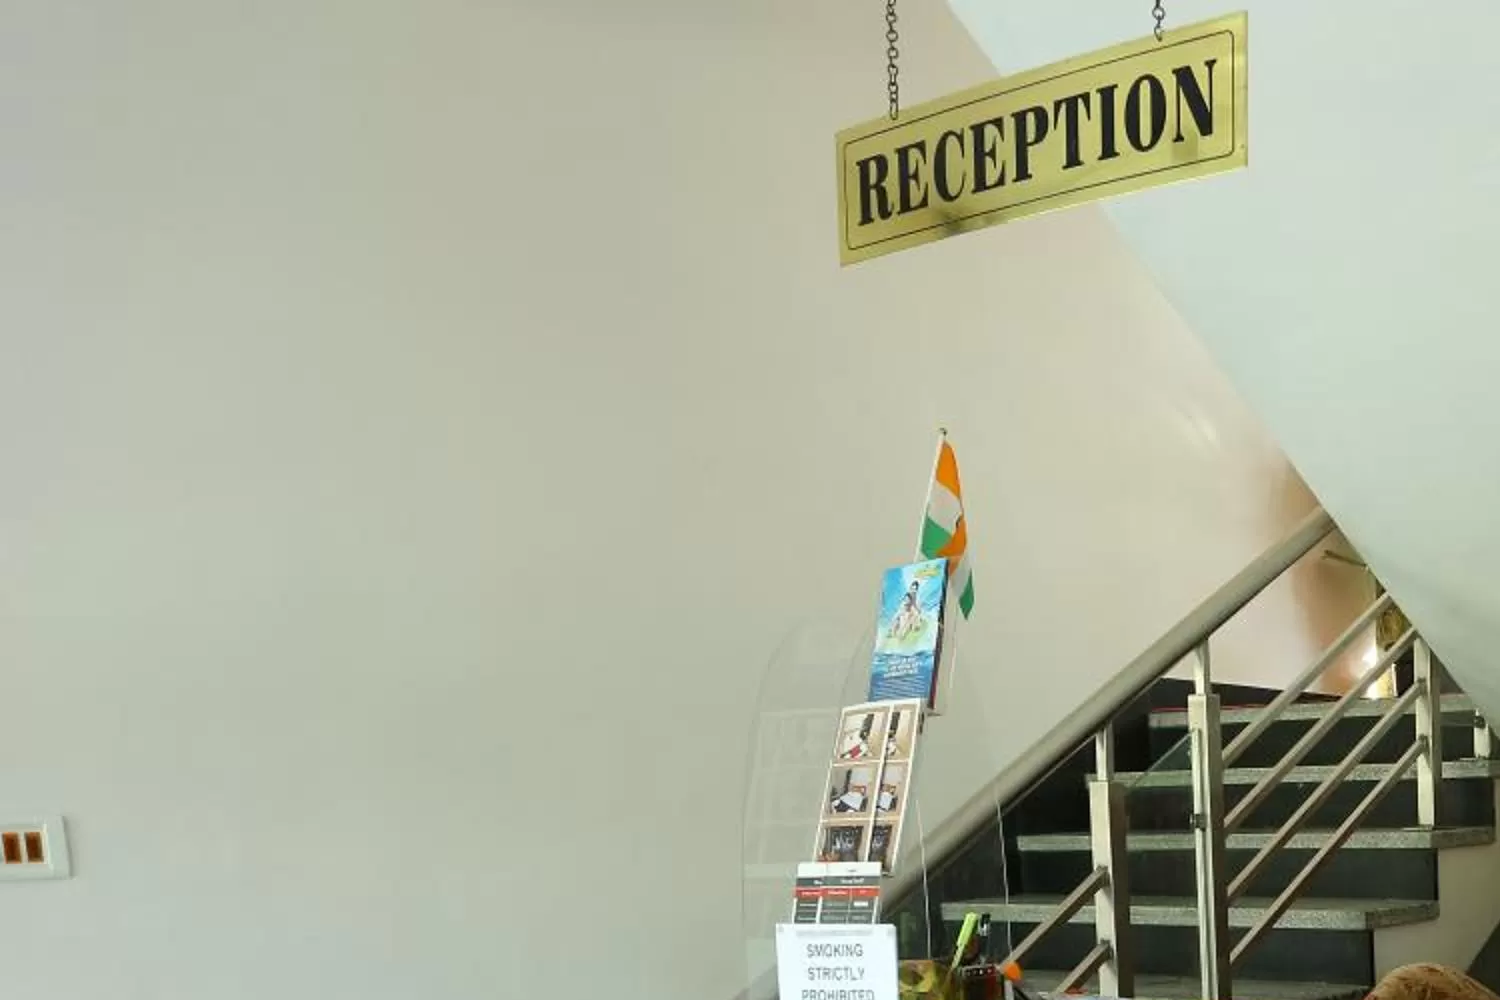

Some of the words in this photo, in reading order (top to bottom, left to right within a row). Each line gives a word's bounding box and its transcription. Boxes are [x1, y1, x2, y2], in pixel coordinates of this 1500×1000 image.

[855, 58, 1218, 227] RECEPTION
[806, 943, 864, 958] SMOKING
[807, 966, 865, 981] STRICTLY
